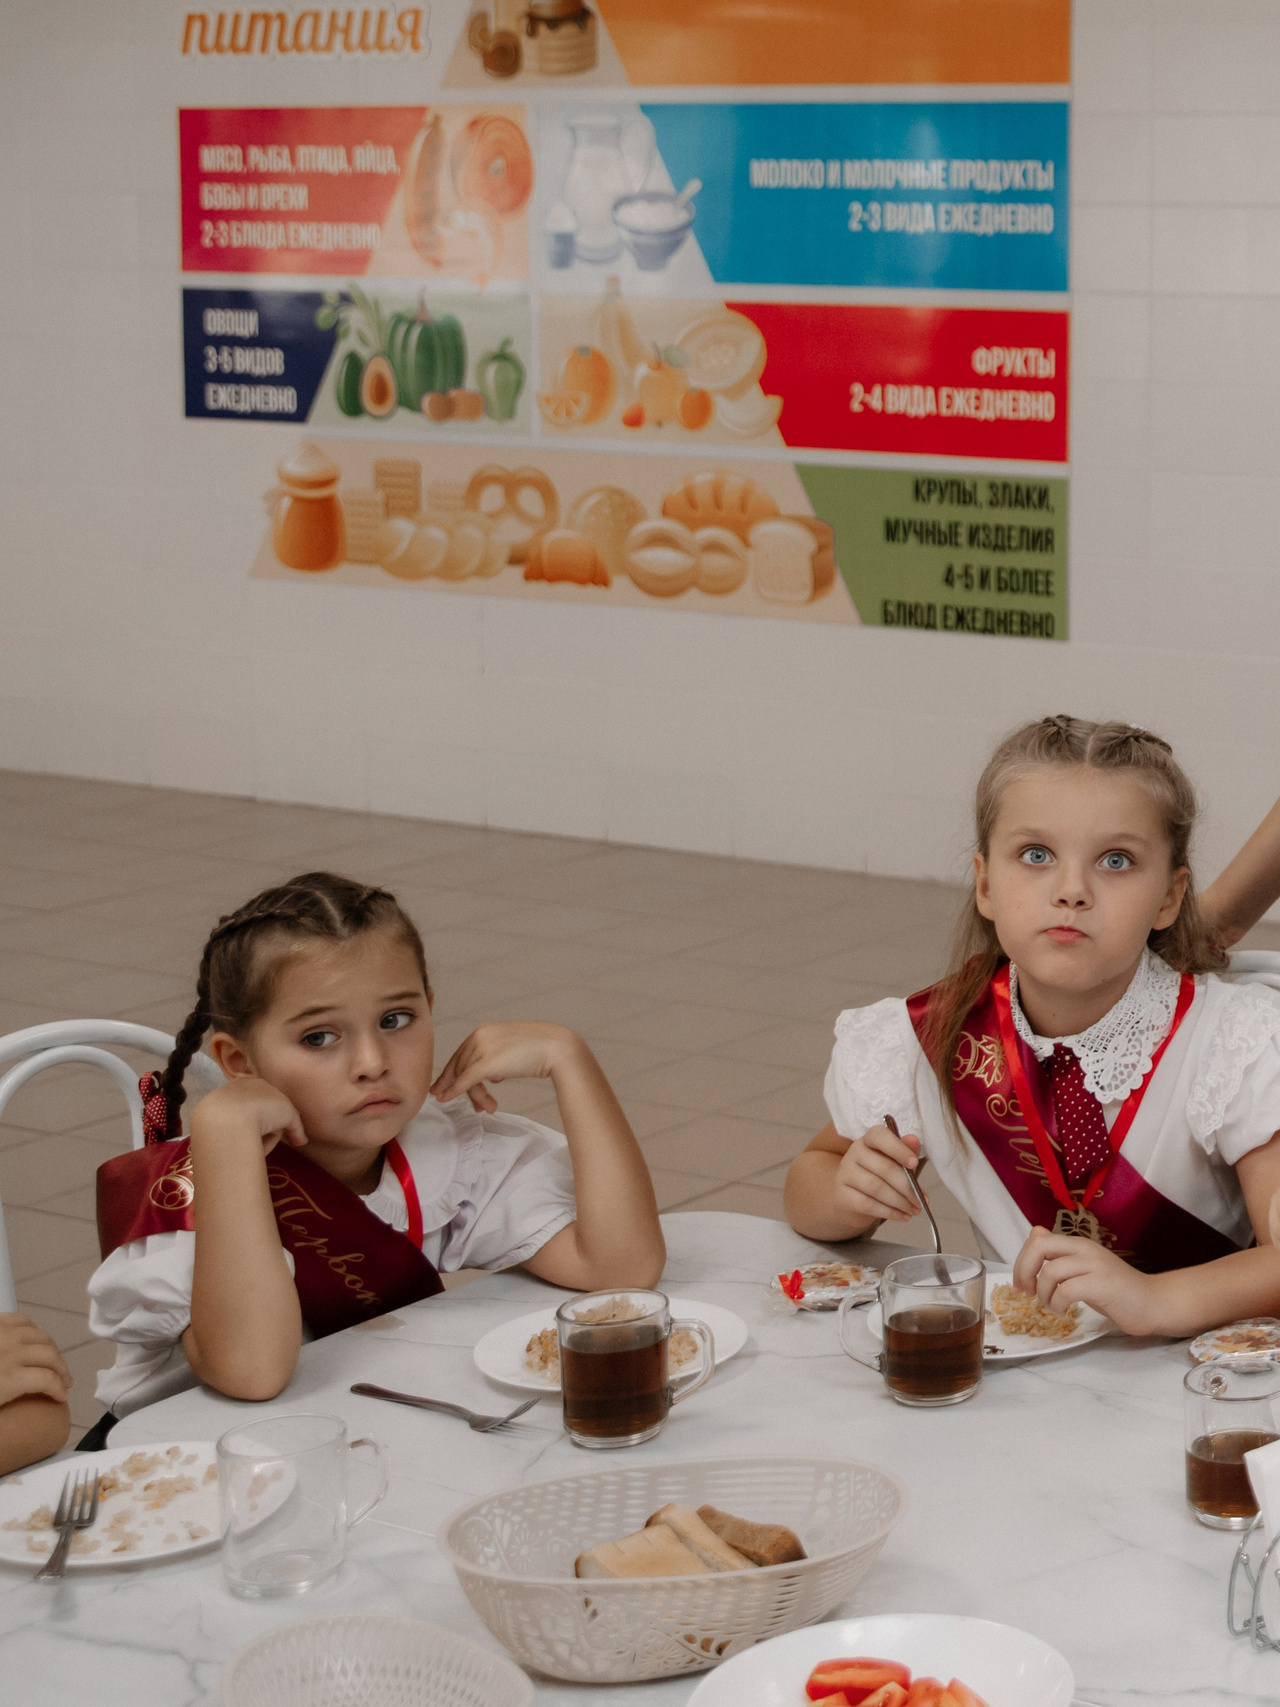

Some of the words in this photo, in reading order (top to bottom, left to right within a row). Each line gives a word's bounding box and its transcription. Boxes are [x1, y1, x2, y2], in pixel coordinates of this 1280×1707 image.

[182, 8, 424, 55] питания
[247, 145, 295, 174] РЫБА,
[296, 145, 352, 175] ПТИЦА,
[750, 159, 825, 189] МОЛОКО
[827, 159, 841, 189] И
[843, 159, 946, 190] МОЛОЧНЫЕ
[948, 160, 1054, 193] ПРОДУКТЫ
[201, 182, 245, 210] БОБЫ
[247, 183, 258, 210] И
[261, 183, 308, 211] ОРЕХИ
[201, 219, 229, 248] 2-3
[230, 220, 286, 250] БЛЮДА
[288, 221, 380, 252] ЕЖЕДНЕВНО
[848, 201, 882, 232] 2-3
[884, 202, 935, 234] ВИДА
[938, 203, 1054, 236] ЕЖЕДНЕВНО
[204, 308, 259, 339] ОВОЩИ
[232, 347, 285, 377] ВИДОВ
[971, 346, 1055, 378] ФРУКТЫ
[205, 382, 297, 414] ЕЖЕДНЕВНО
[849, 383, 883, 412] 2-4
[884, 385, 936, 418] ВИДА
[938, 386, 1055, 422] ЕЖЕДНЕВНО
[914, 477, 983, 510] КРУПЫ,
[988, 481, 1055, 514] ЗЛАКИ,
[885, 517, 962, 548] МУЧНЫЕ
[968, 522, 1055, 555] ИЗДЕЛИЯ
[944, 562, 974, 591] 4-5
[980, 565, 991, 593] И
[996, 568, 1055, 597] БОЛЕЕ
[883, 599, 938, 630] БЛЮД
[943, 604, 1055, 638] ЕЖЕДНЕВНО
